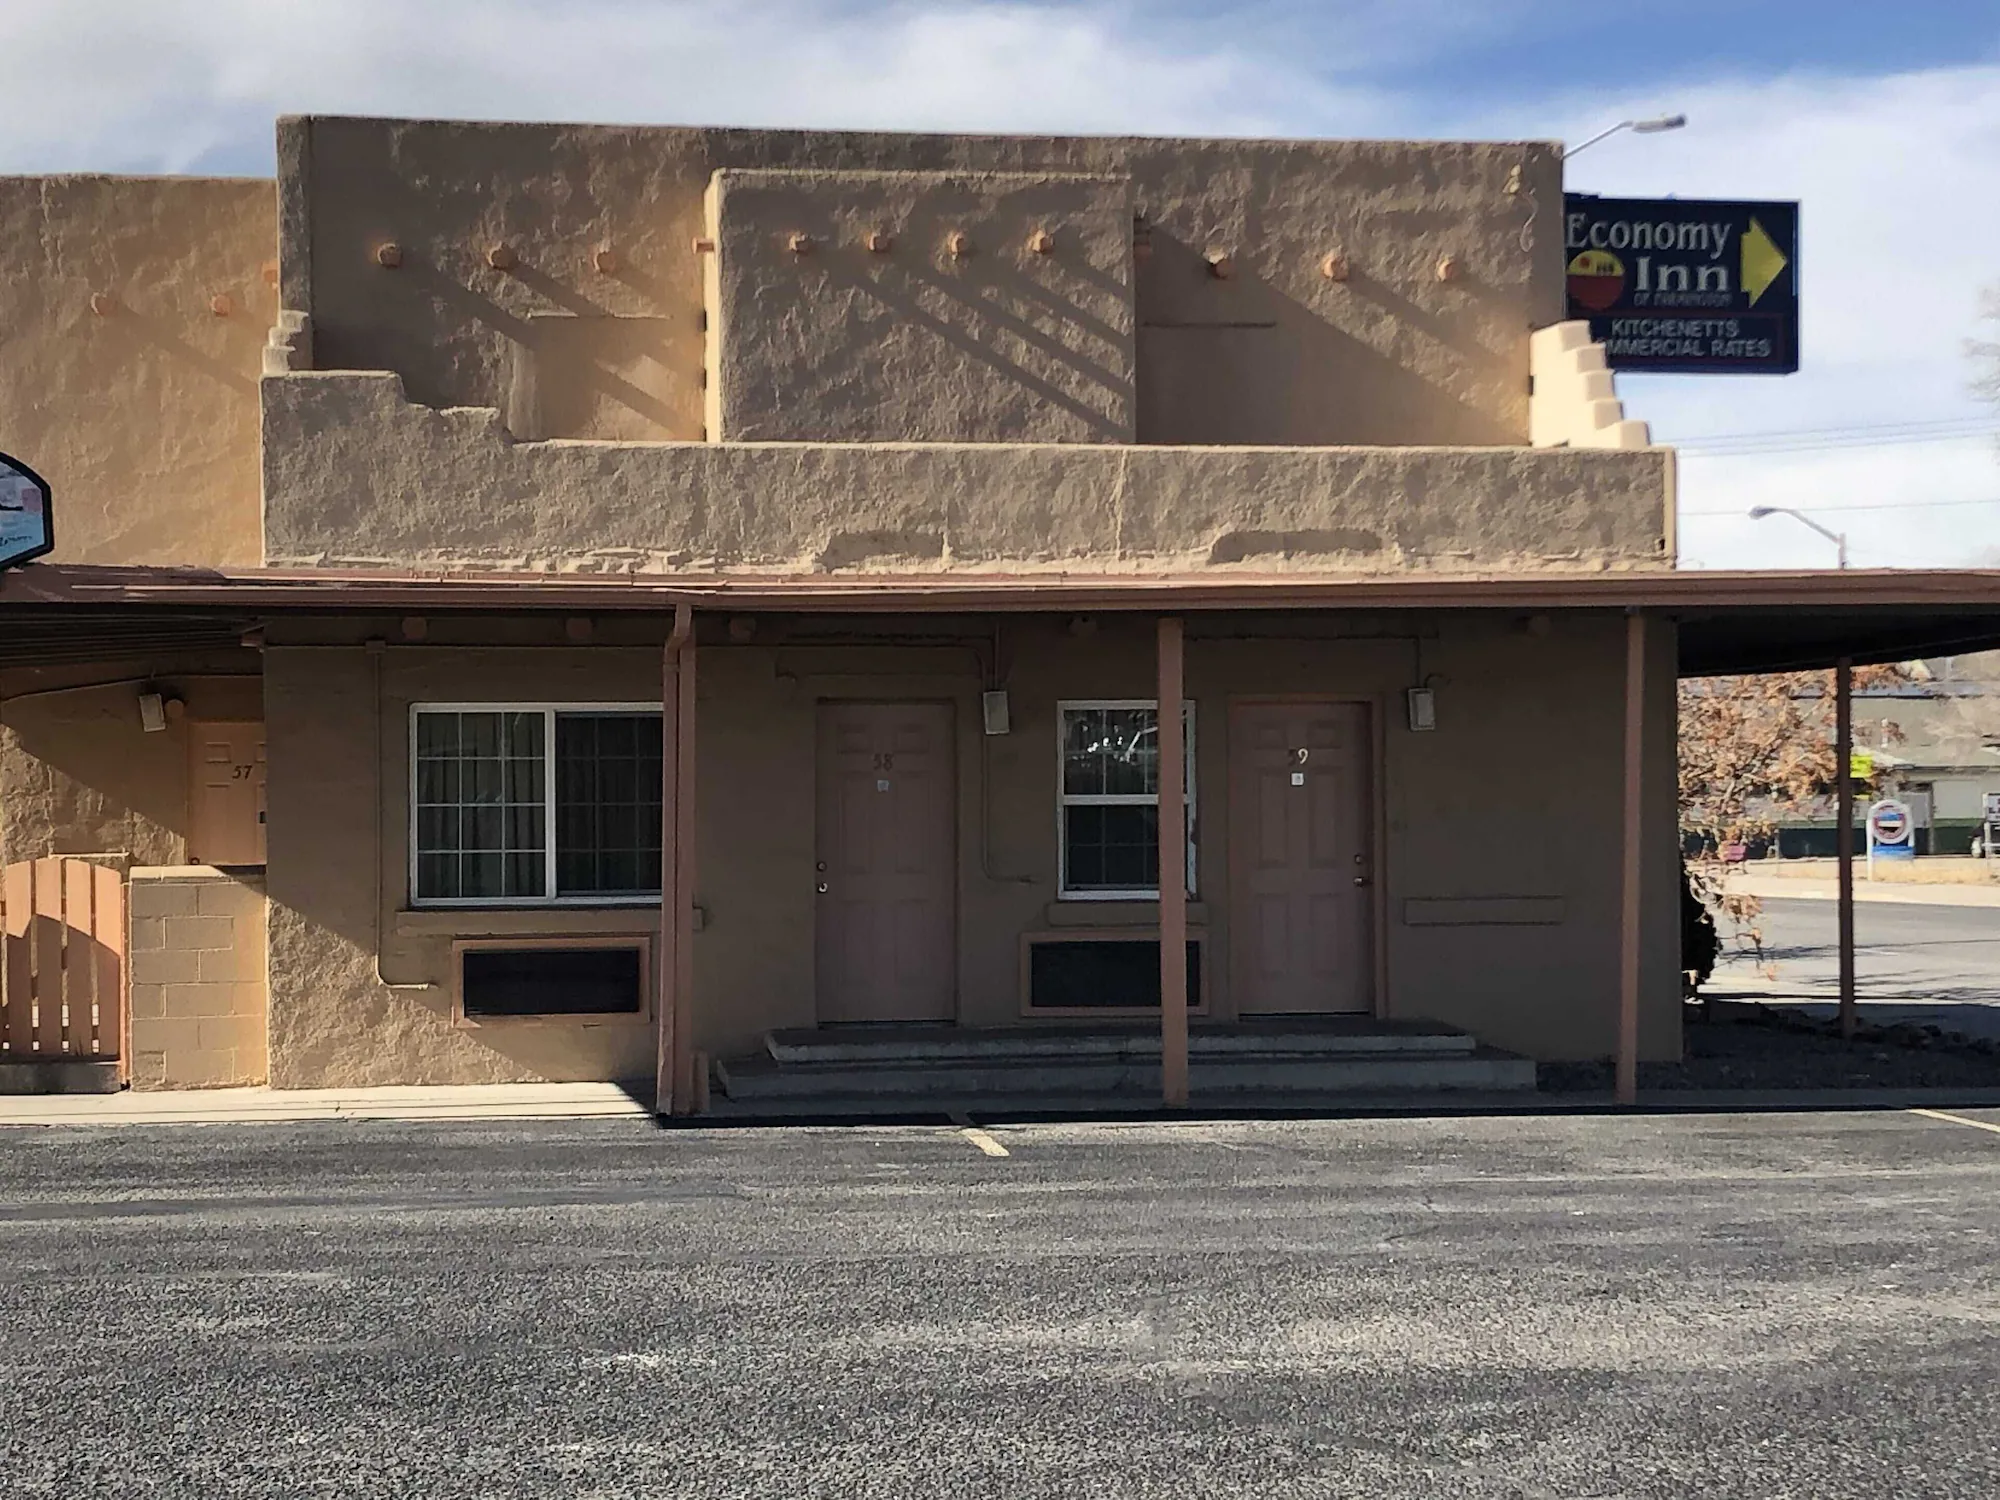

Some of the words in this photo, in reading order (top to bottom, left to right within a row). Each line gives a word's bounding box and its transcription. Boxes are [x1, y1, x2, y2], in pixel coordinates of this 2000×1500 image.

[1566, 212, 1732, 259] Economy
[1634, 256, 1730, 292] Inn
[1611, 319, 1739, 338] KITCHENETTS
[1598, 338, 1705, 357] MMERCIAL
[1711, 338, 1771, 357] RATES
[232, 765, 253, 780] 57
